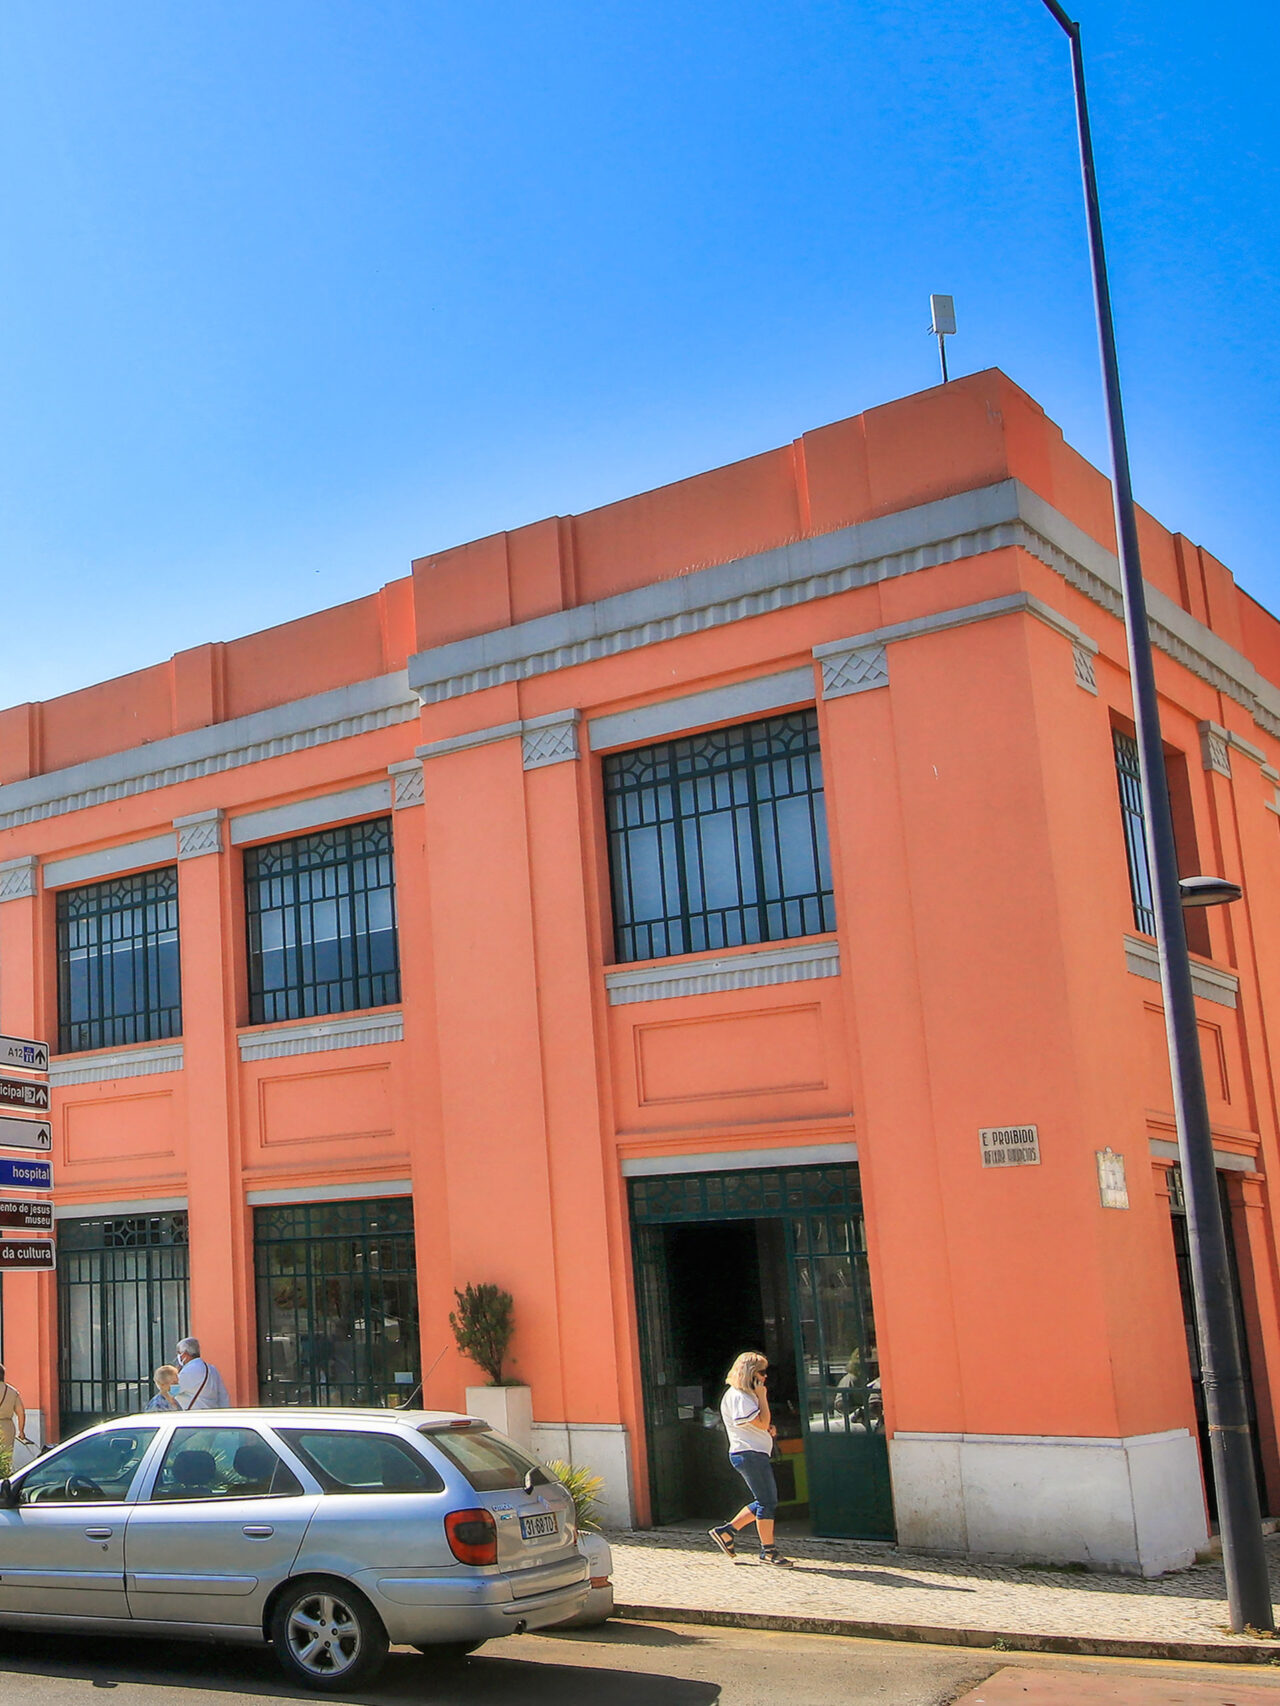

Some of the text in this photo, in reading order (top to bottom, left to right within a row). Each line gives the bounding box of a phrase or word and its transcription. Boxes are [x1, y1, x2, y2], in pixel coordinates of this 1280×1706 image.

[8, 1047, 23, 1058] A12
[992, 1128, 1034, 1146] PROIBIDO
[12, 1165, 50, 1181] hospital
[19, 1203, 28, 1213] de
[30, 1203, 51, 1215] jesus
[25, 1216, 51, 1225] museu
[2, 1246, 15, 1259] da
[17, 1246, 51, 1259] cultura
